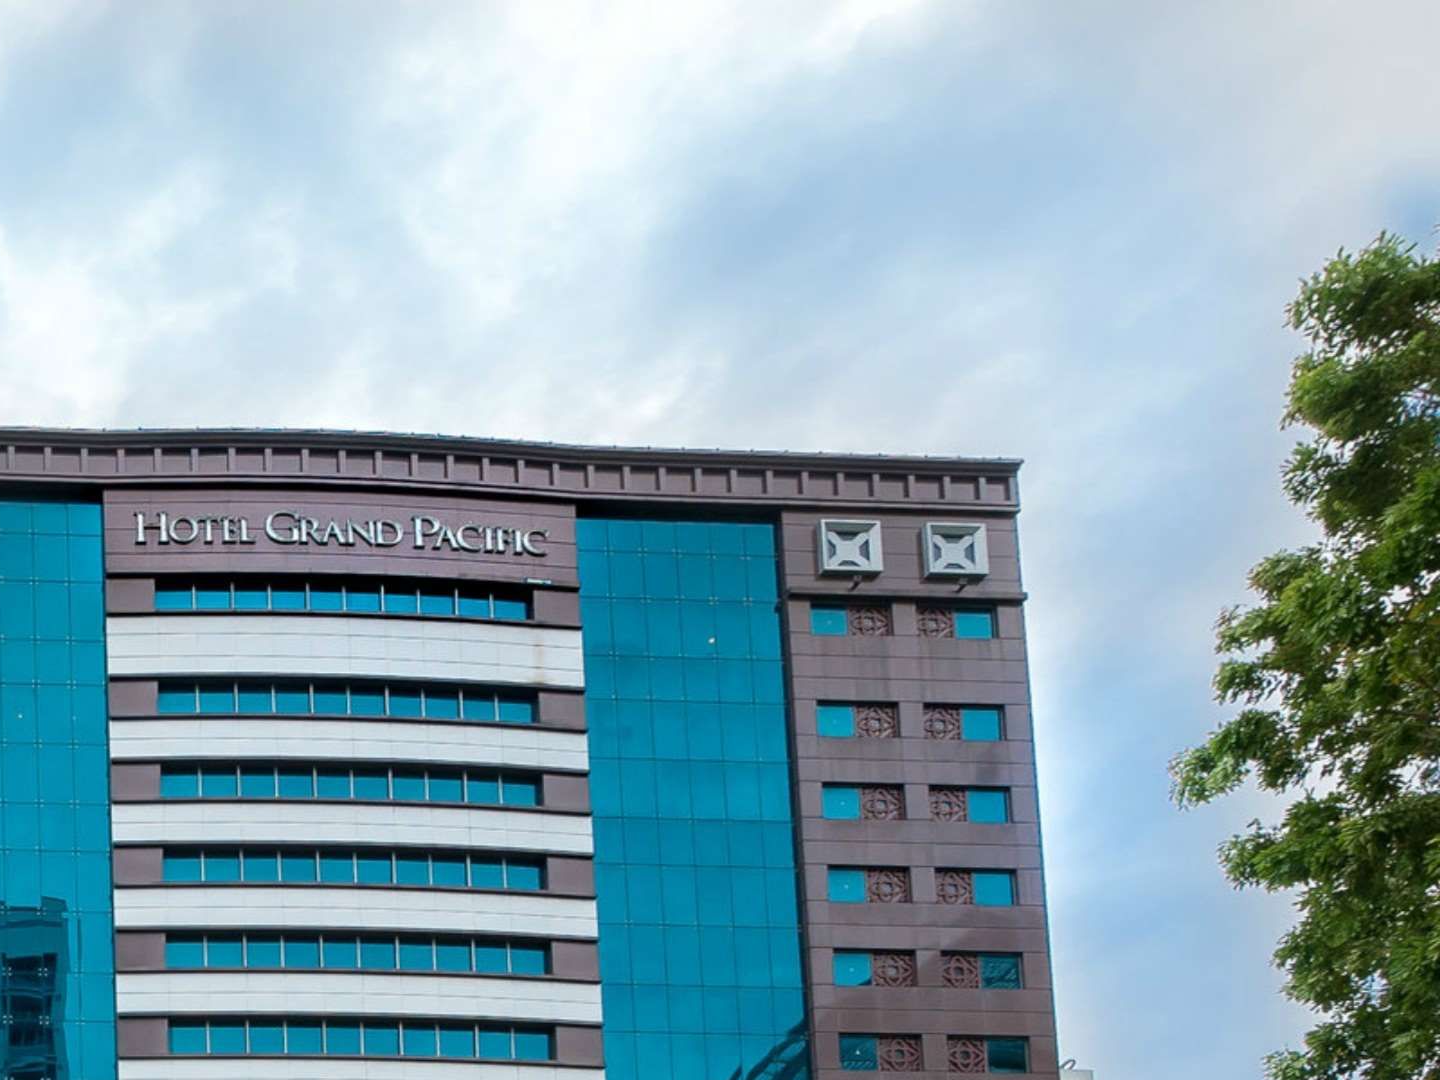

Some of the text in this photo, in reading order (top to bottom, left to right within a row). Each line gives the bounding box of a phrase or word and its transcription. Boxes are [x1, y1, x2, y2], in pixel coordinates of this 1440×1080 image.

[134, 509, 550, 557] HOTEL GRAND PACIFIC
